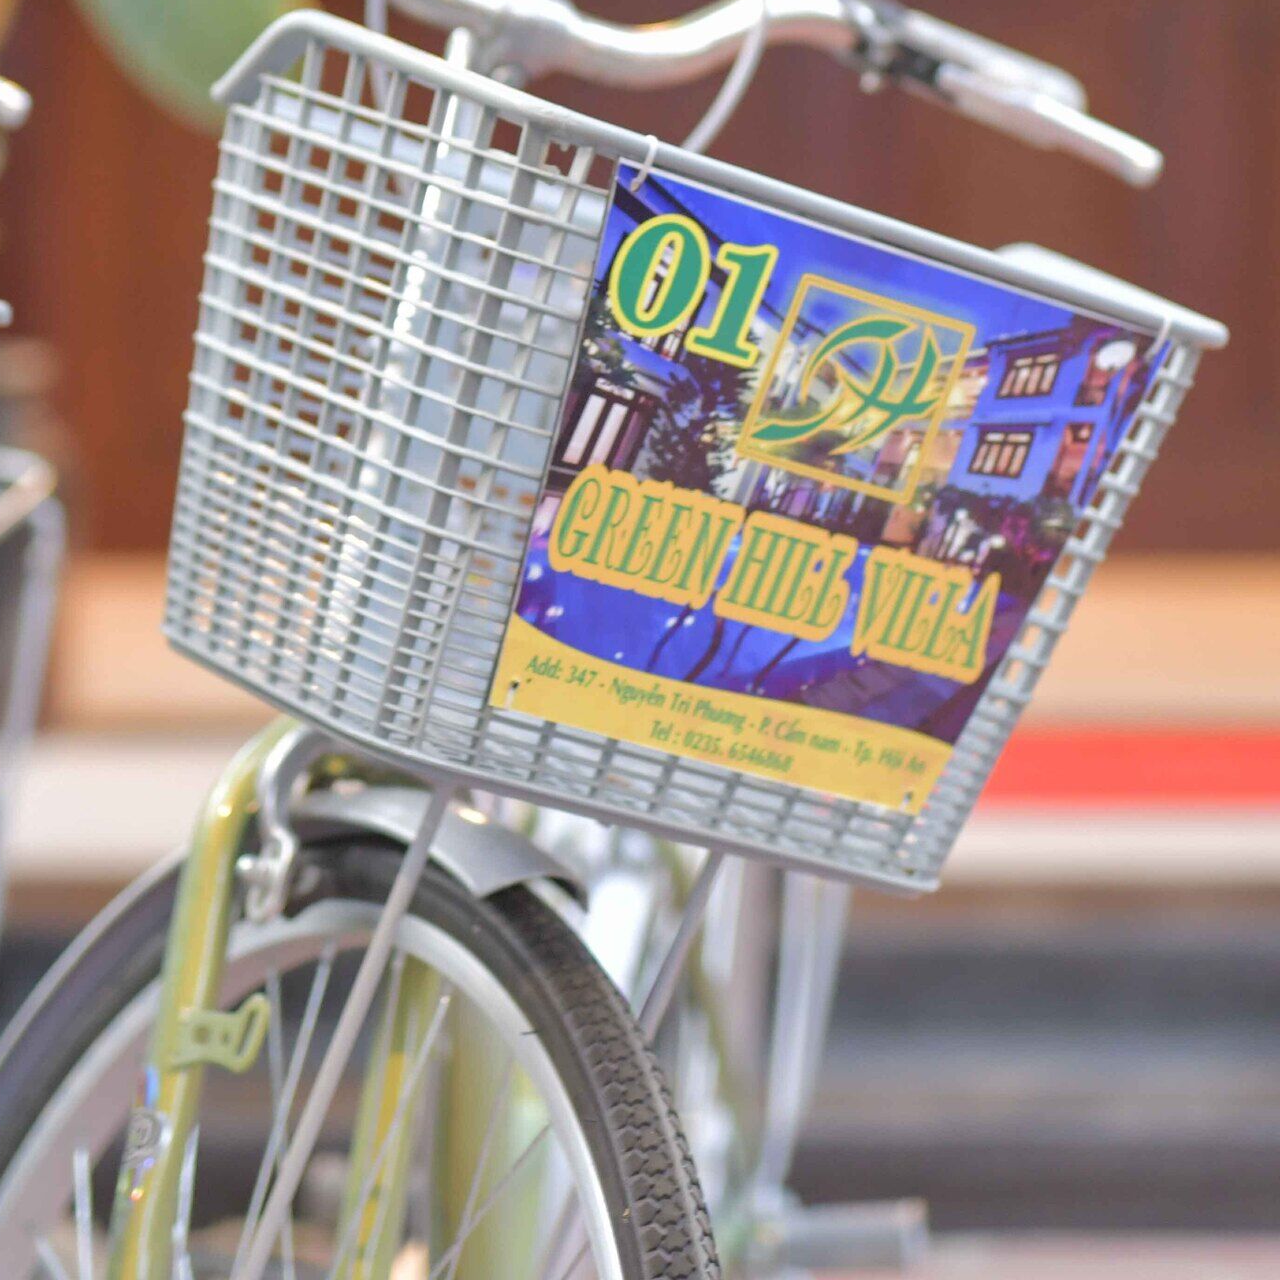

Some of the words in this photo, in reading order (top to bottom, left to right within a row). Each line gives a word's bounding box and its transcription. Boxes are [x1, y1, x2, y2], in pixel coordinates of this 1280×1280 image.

[610, 215, 779, 367] 01
[558, 478, 735, 594] GREEN
[722, 526, 847, 628] HILL
[862, 561, 991, 668] VILLA
[525, 655, 563, 680] Add:
[565, 665, 598, 688] 347
